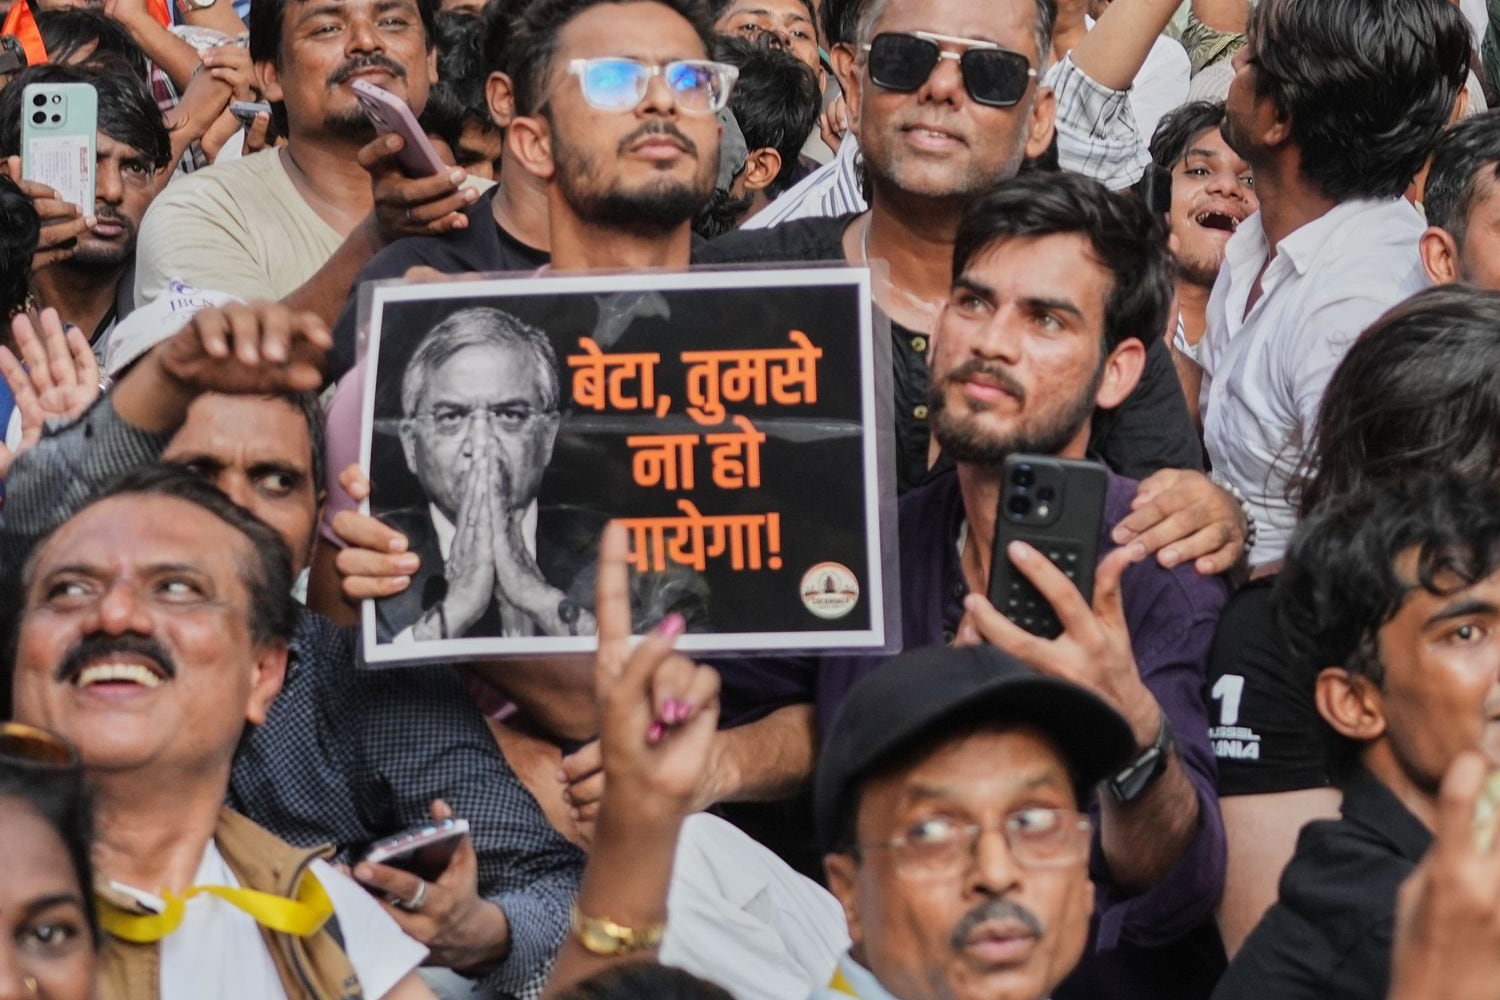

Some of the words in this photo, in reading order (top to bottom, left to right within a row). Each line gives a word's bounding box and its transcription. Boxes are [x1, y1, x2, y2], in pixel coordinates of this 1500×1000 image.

[567, 336, 672, 418] बेटा,
[680, 330, 822, 426] तुमसे
[626, 434, 700, 490] ना
[705, 415, 766, 489] हो
[1211, 673, 1245, 726] 1
